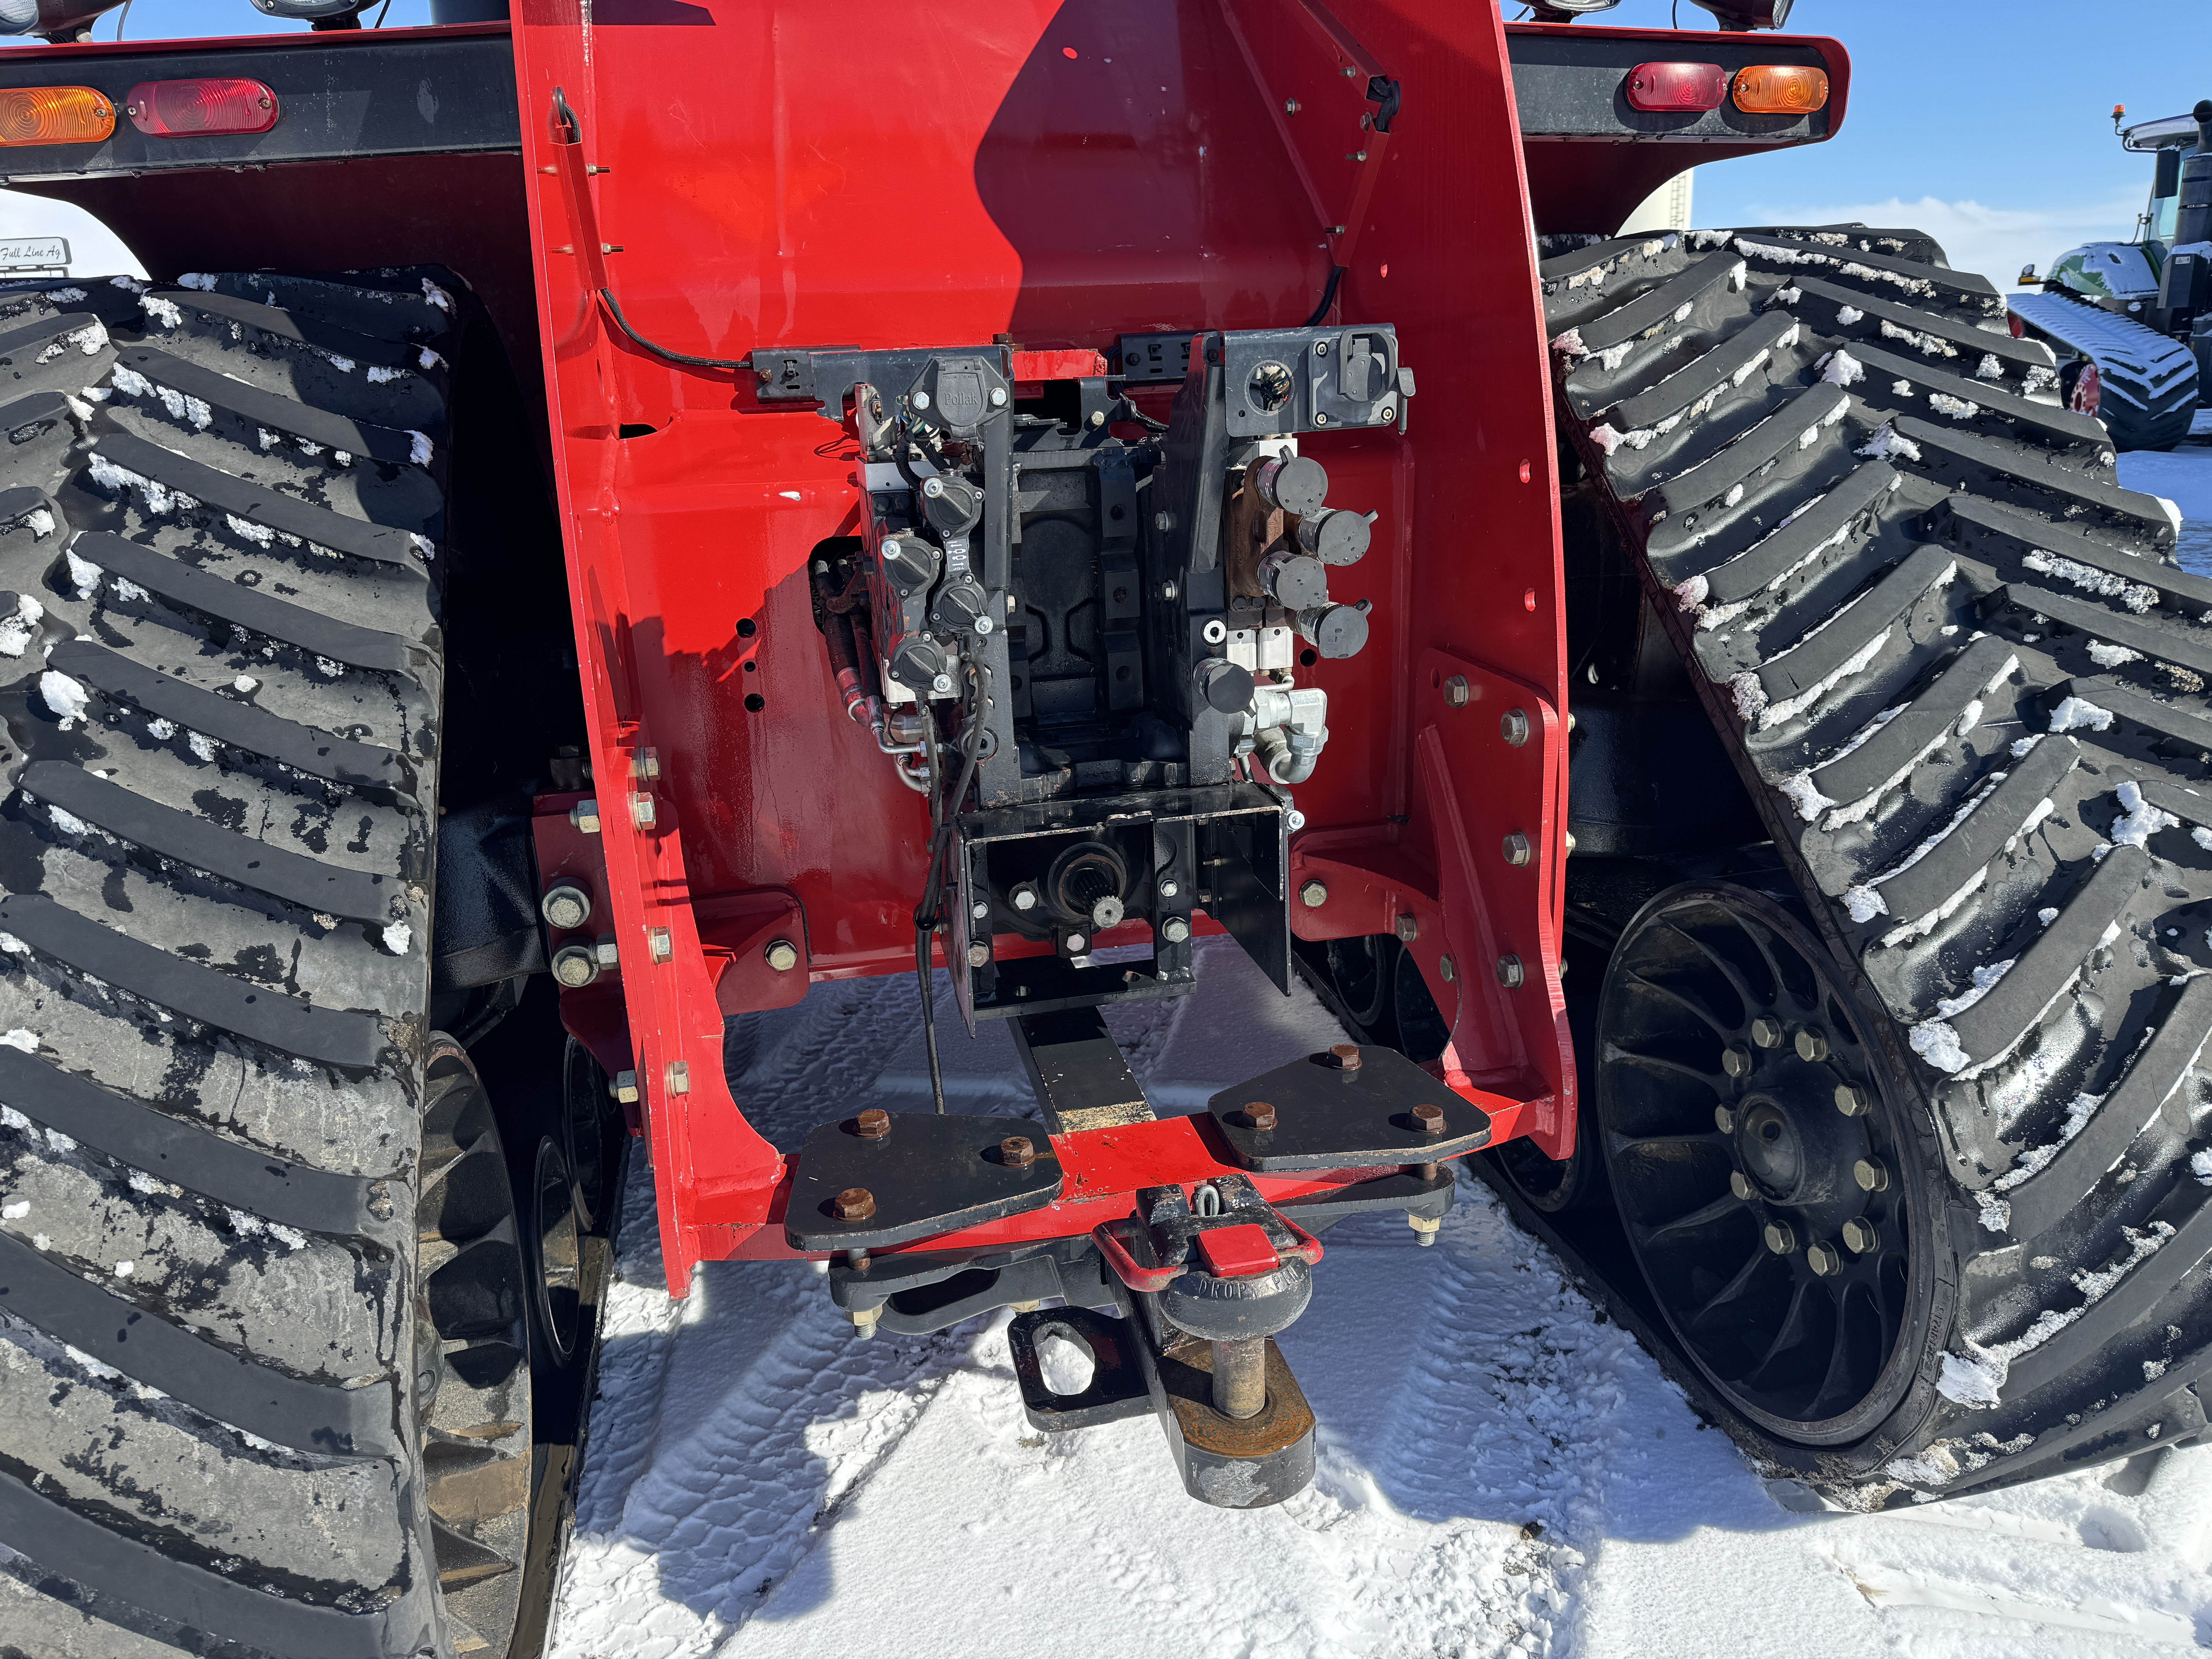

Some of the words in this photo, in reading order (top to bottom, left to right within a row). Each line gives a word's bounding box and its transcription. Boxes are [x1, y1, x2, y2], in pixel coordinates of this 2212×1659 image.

[0, 247, 21, 261] Full
[24, 246, 44, 257] Line
[46, 245, 60, 259] Ag
[944, 392, 979, 405] Pollak
[1199, 1279, 1246, 1298] DROP
[1271, 1264, 1299, 1290] PIN
